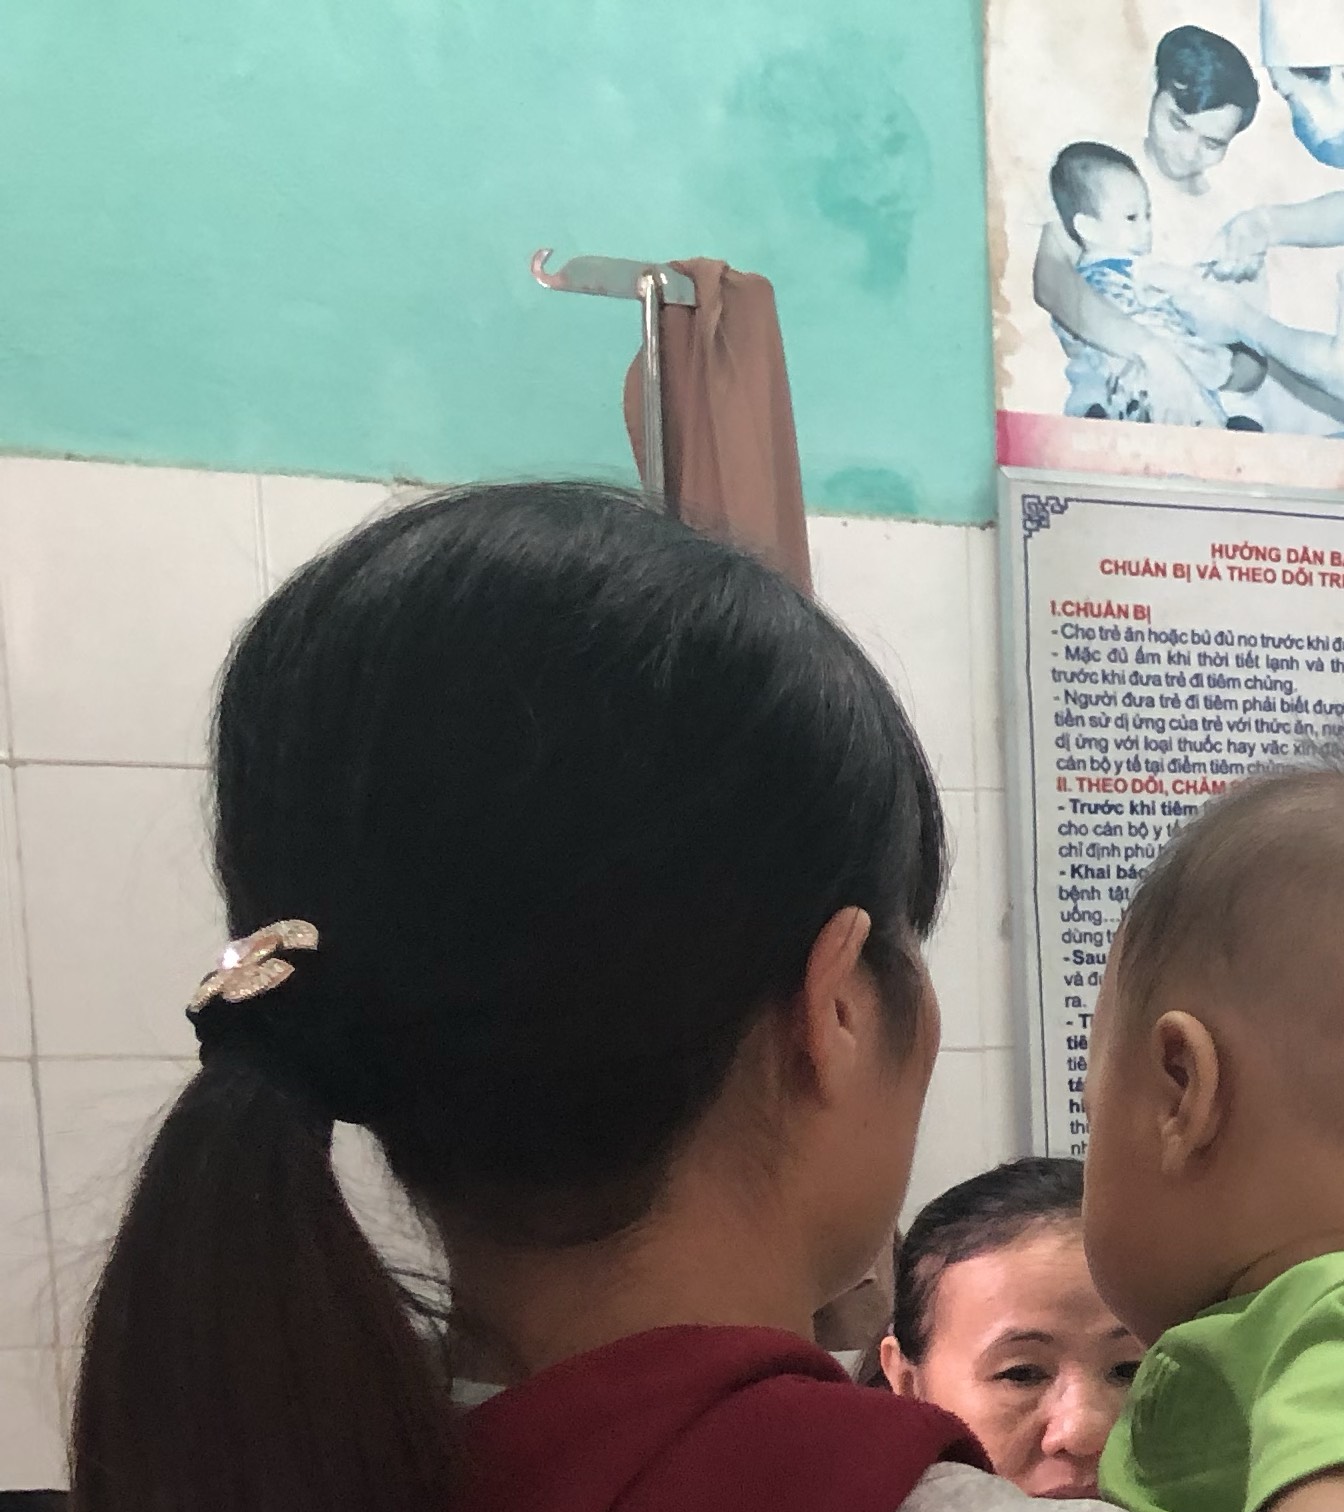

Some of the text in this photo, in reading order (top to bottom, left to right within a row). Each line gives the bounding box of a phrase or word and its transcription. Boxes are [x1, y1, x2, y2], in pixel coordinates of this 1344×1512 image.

[1211, 541, 1281, 563] HƯỚNG
[1287, 545, 1324, 565] DẪN
[1100, 558, 1166, 578] CHUẨN
[1173, 563, 1191, 583] BỊ
[1196, 560, 1221, 580] VÀ
[1227, 566, 1276, 584] THEO
[1133, 604, 1151, 624] BỊ
[1061, 622, 1096, 642] Cho
[1237, 634, 1257, 648] no
[1260, 630, 1304, 650] trước
[1306, 635, 1330, 652] khi
[1167, 648, 1191, 666] khi
[1266, 653, 1299, 674] lạnh
[1052, 667, 1099, 684] trước
[1102, 669, 1125, 685] khi
[1227, 738, 1256, 757] hay
[1114, 761, 1124, 775] y
[1075, 776, 1128, 794] THEO
[1069, 798, 1125, 815] Trước
[1129, 800, 1156, 816] khi
[1058, 819, 1088, 836] cho
[1153, 825, 1162, 840] y
[1070, 864, 1111, 879] Khai
[1073, 950, 1106, 965] Sau
